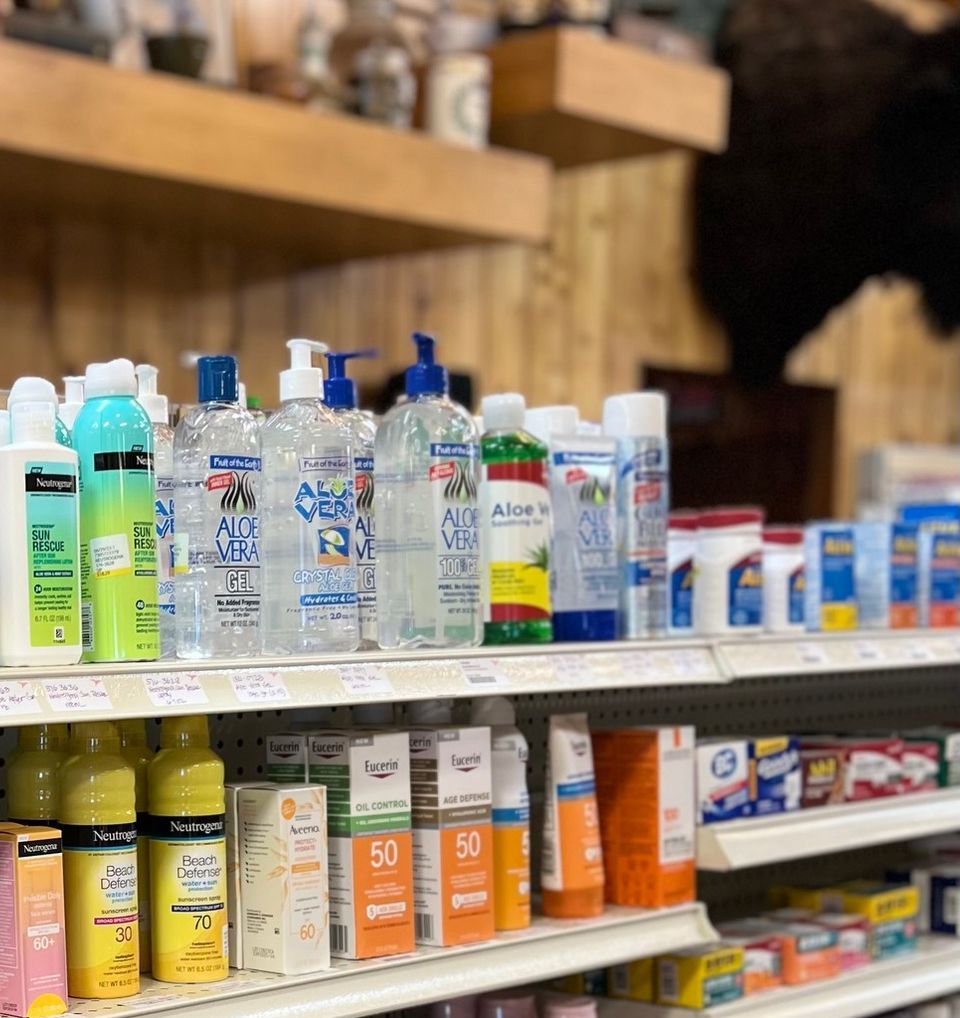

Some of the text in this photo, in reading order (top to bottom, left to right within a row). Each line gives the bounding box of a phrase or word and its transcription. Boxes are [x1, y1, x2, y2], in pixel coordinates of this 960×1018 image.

[294, 501, 355, 522] VERA
[492, 503, 534, 517] Aloe
[134, 527, 151, 537] SUN
[217, 516, 258, 538] ALOE
[32, 530, 50, 541] SUN
[442, 530, 478, 550] VERA
[32, 541, 65, 552] RESCUE
[216, 540, 259, 563] VERA
[226, 570, 254, 592] GEL
[270, 741, 300, 753] Eucerin
[365, 760, 398, 773] Eucerin
[452, 755, 481, 766] Eucerin
[443, 792, 490, 804] AGE DEFENSE
[356, 800, 409, 812] OIL CONTROL
[170, 822, 223, 833] Neutrogena
[23, 844, 57, 854] Neutrogena
[456, 831, 480, 858] 50
[370, 840, 398, 868] 50
[183, 855, 217, 867] Beach
[107, 866, 135, 878] Beach
[177, 867, 219, 879] Defense
[192, 915, 212, 930] 70
[116, 927, 132, 943] 30
[300, 923, 315, 940] 60
